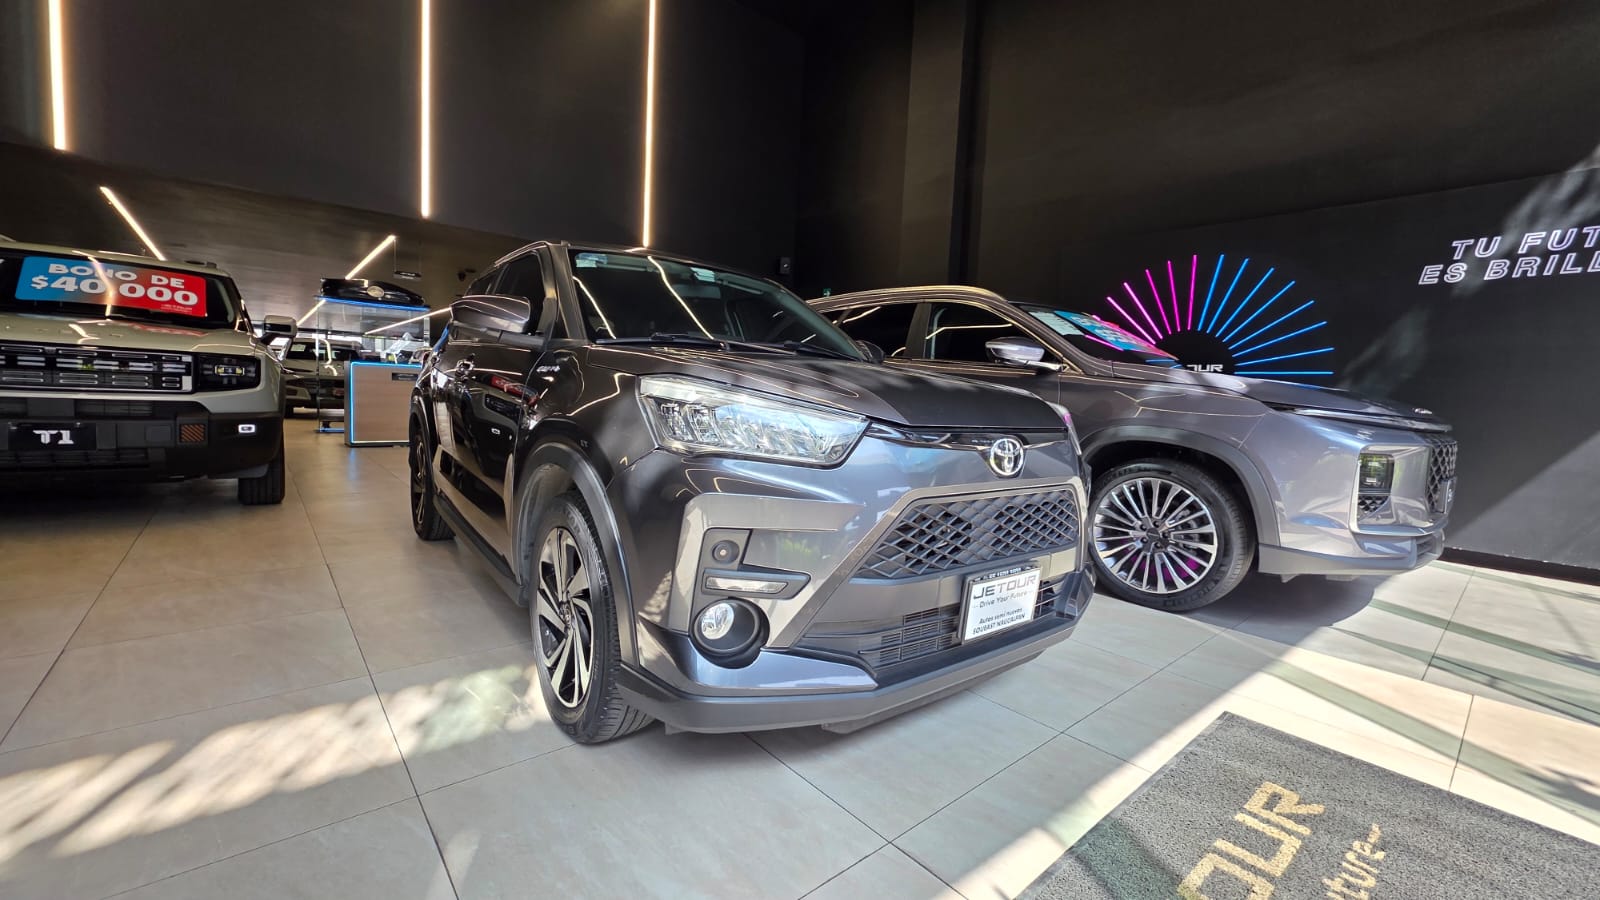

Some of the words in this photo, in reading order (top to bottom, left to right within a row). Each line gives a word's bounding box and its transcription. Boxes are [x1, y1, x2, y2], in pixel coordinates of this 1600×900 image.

[1451, 236, 1502, 260] TU
[48, 263, 137, 281] BONO
[151, 275, 185, 289] DE
[1418, 262, 1468, 285] ES
[32, 429, 75, 445] T1
[973, 574, 1037, 599] JETOUR
[979, 599, 995, 608] Drive
[997, 595, 1010, 603] Your
